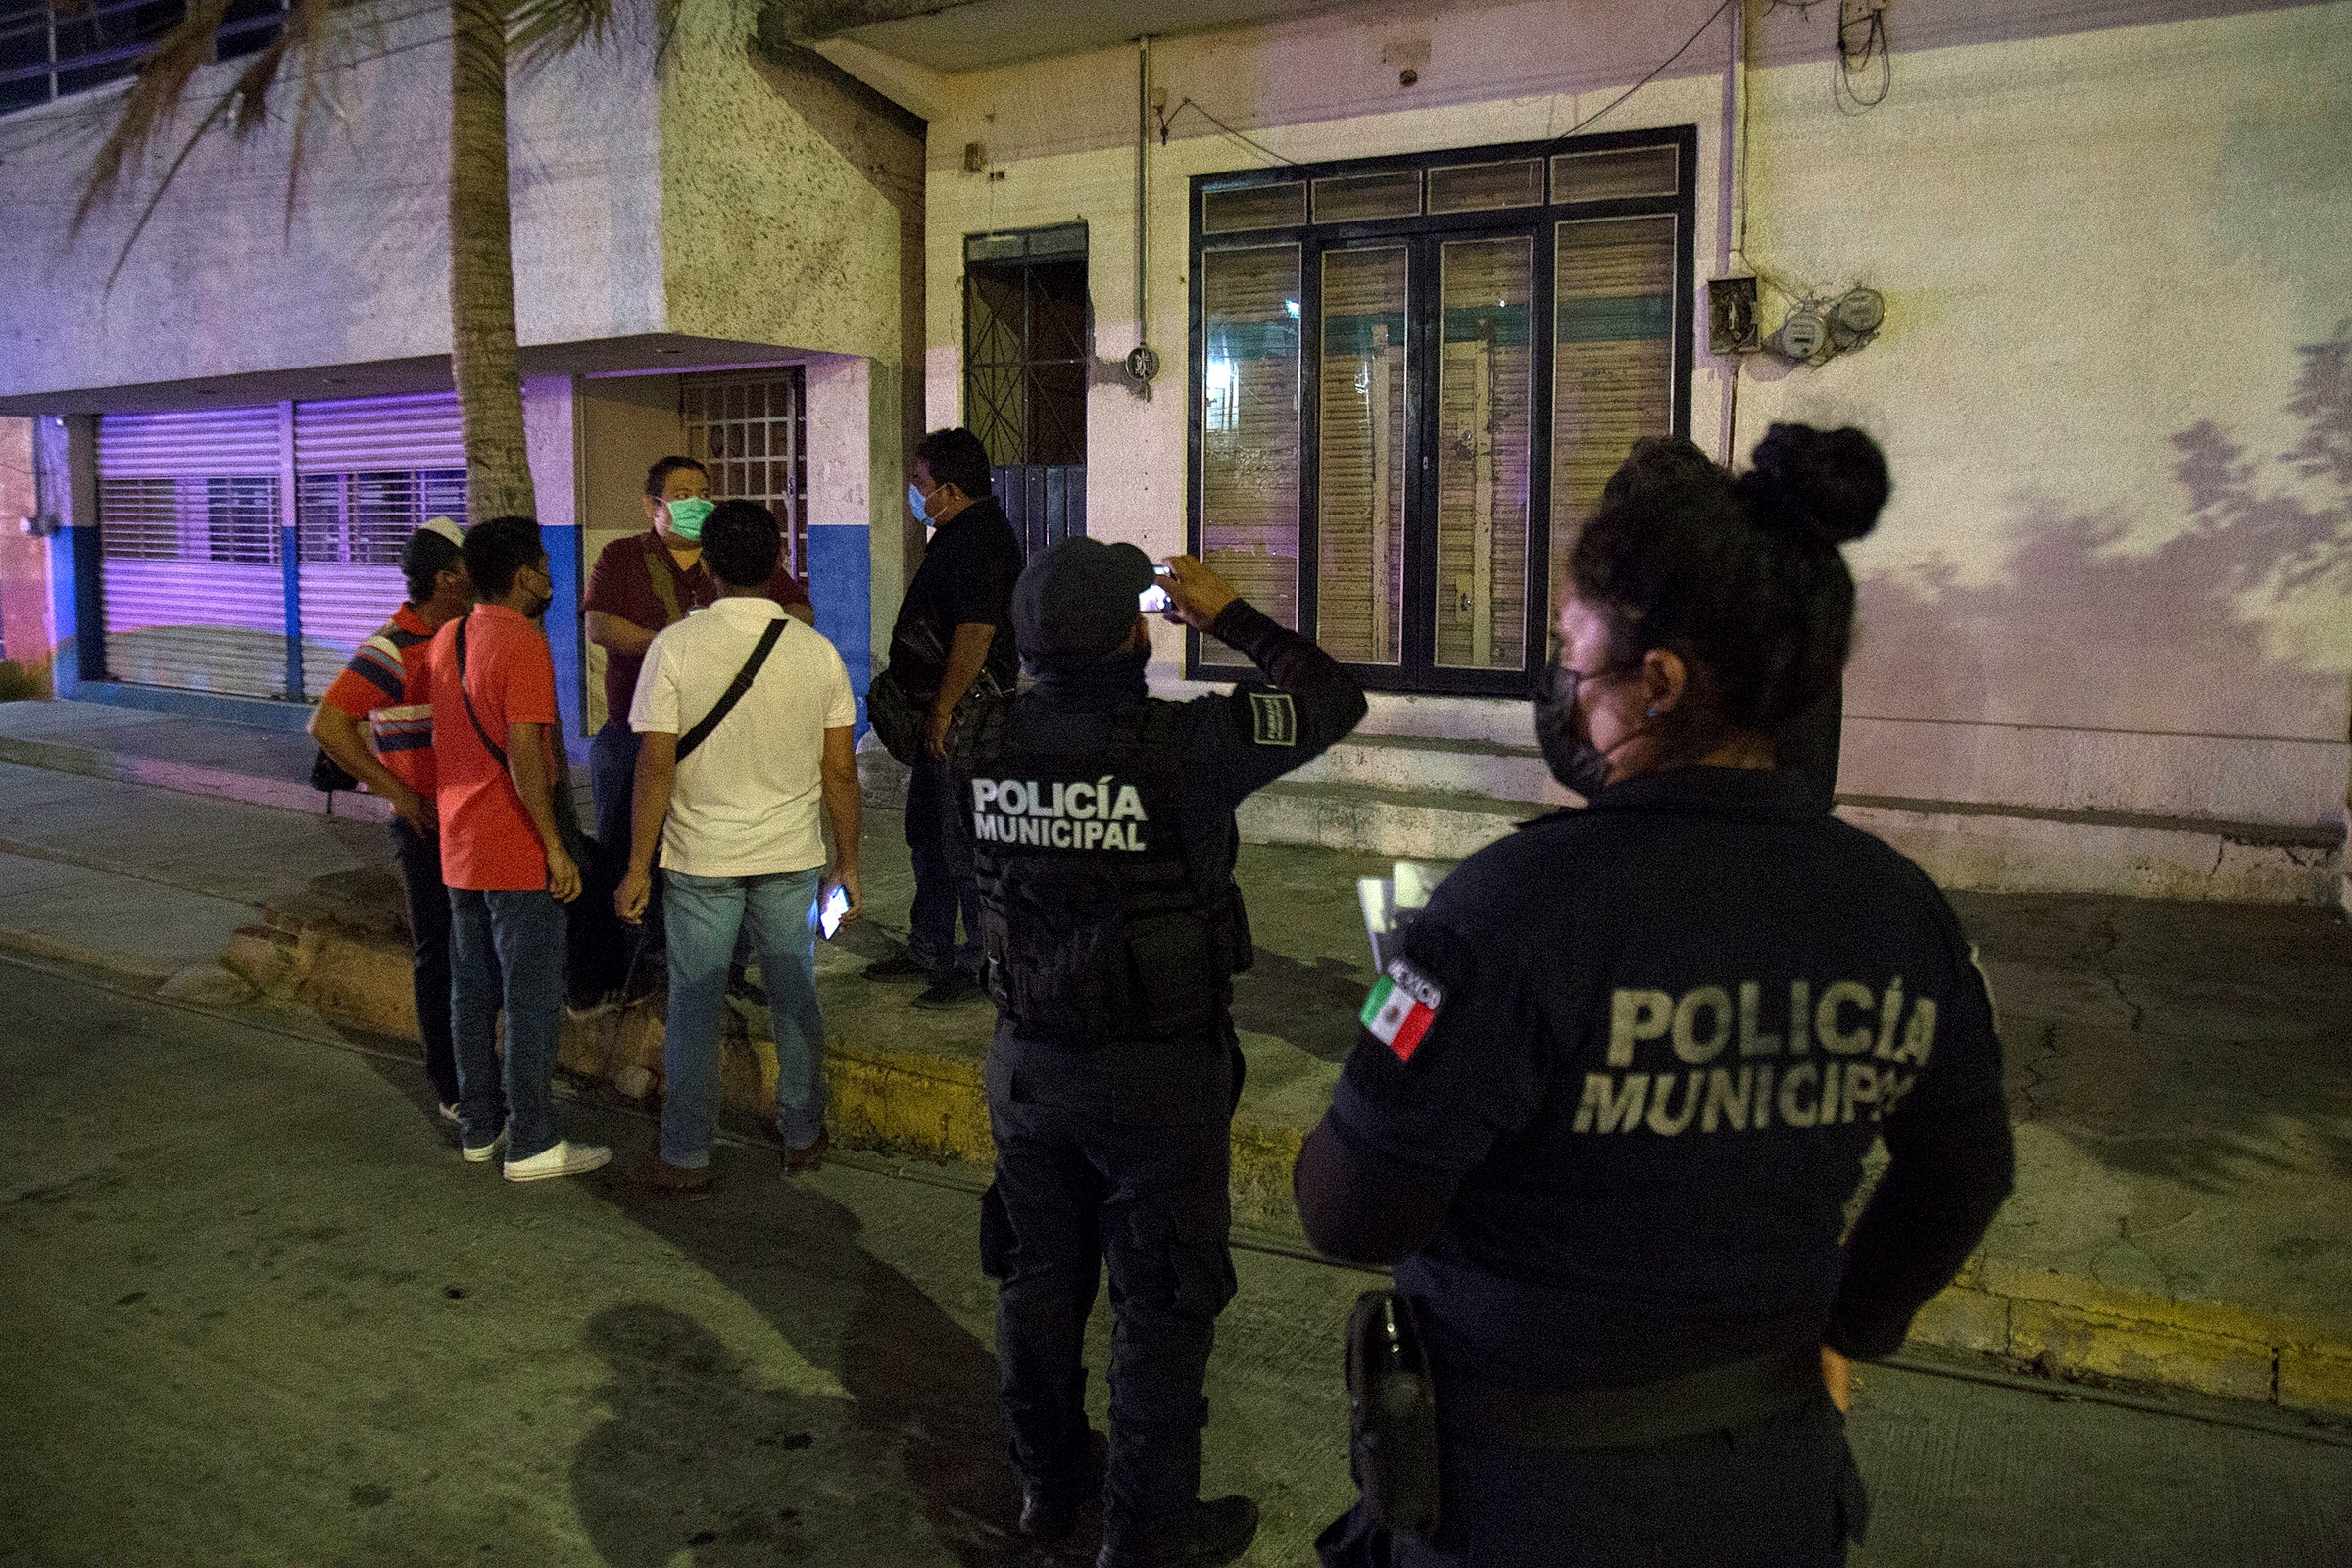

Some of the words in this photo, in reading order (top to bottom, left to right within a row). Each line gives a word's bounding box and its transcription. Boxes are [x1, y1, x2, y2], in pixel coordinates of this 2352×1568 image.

[972, 775, 1148, 821] POLICÍA
[973, 812, 1146, 852] MUNICIPAL
[1607, 975, 1936, 1066] POLICÍA
